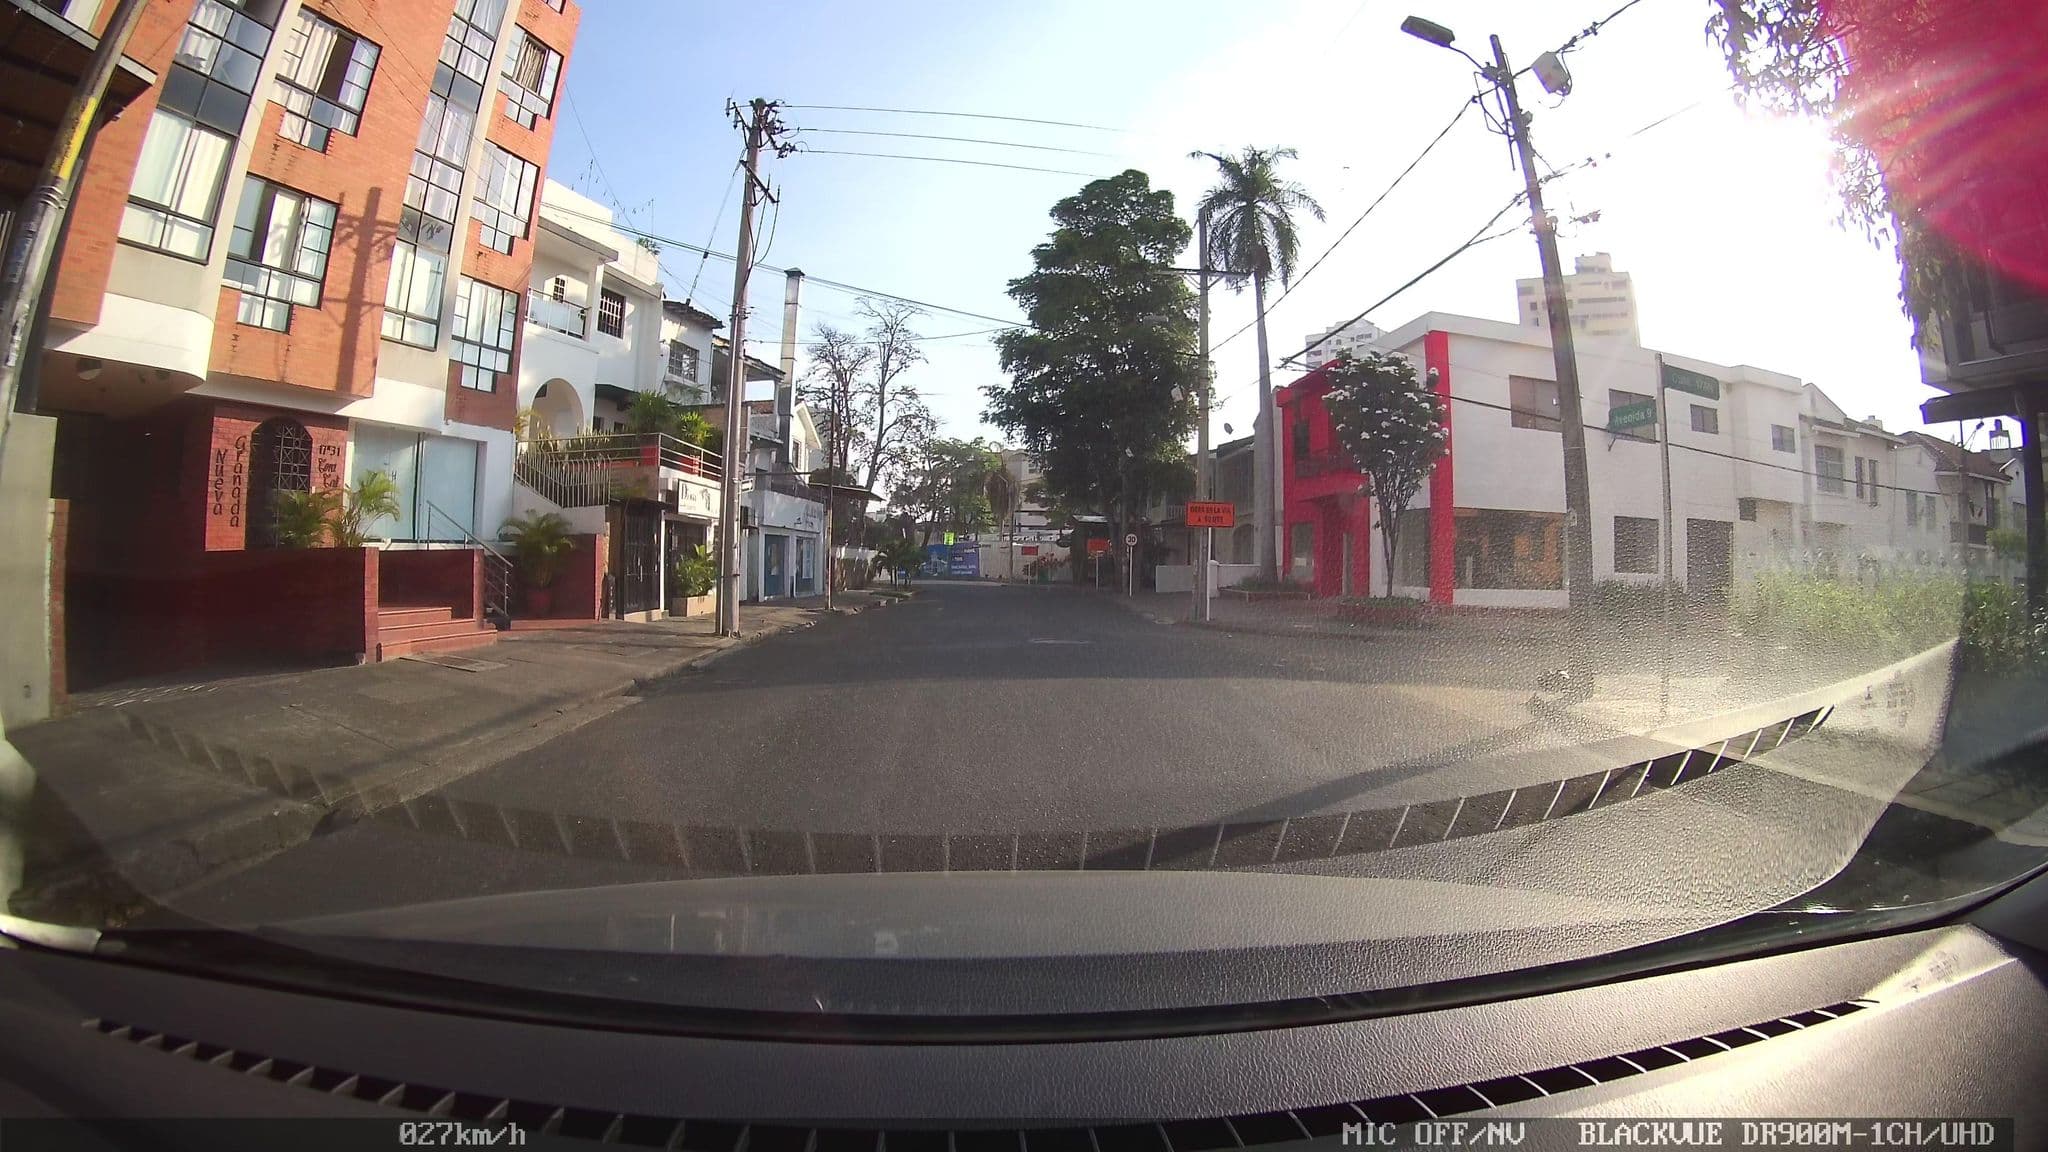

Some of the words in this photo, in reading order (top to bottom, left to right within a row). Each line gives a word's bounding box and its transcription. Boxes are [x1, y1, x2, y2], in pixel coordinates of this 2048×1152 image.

[1614, 410, 1645, 426] Avenida
[1646, 408, 1652, 418] 9
[212, 448, 228, 515] Nueva
[229, 435, 247, 527] Granada
[1127, 535, 1136, 543] 30
